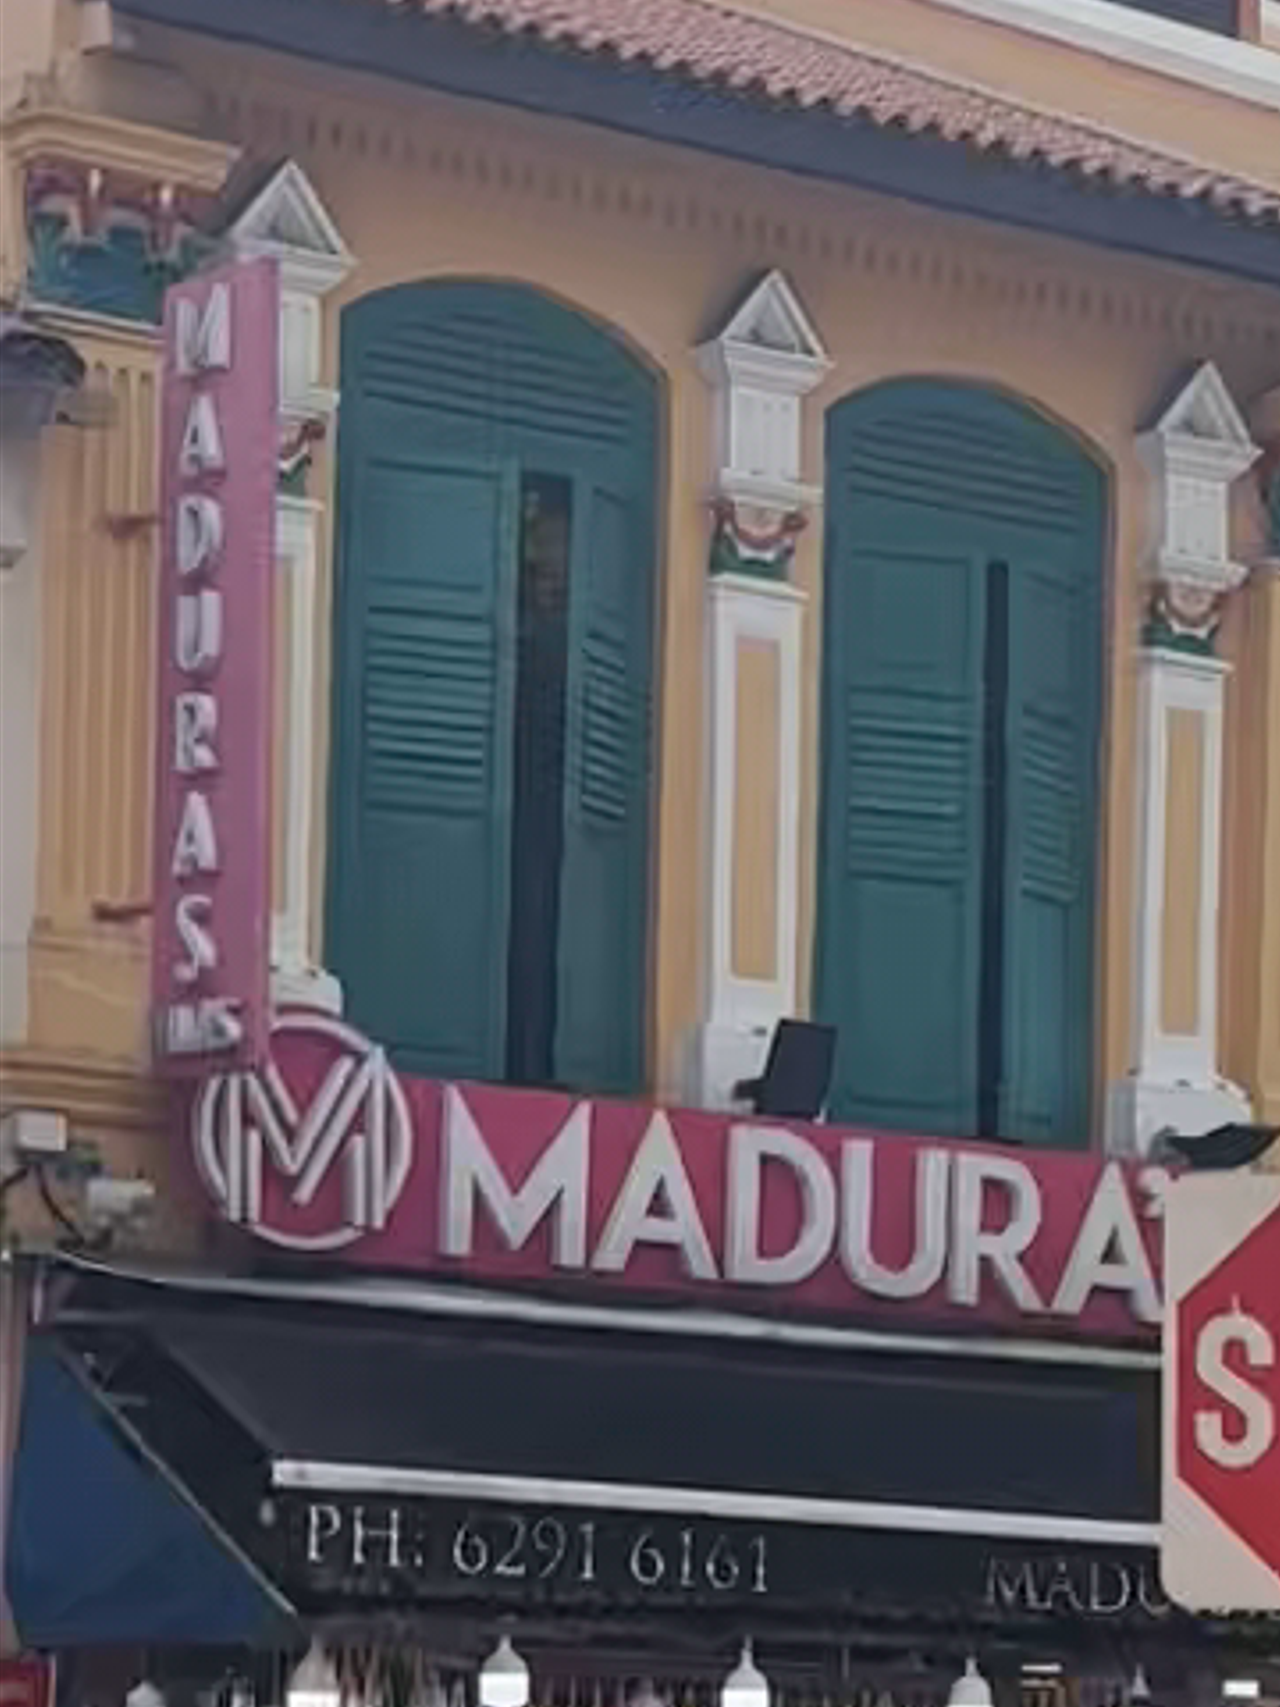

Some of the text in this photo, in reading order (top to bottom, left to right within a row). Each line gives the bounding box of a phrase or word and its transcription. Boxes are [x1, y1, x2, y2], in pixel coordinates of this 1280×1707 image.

[306, 1504, 768, 1594] PH: 6291 6161
